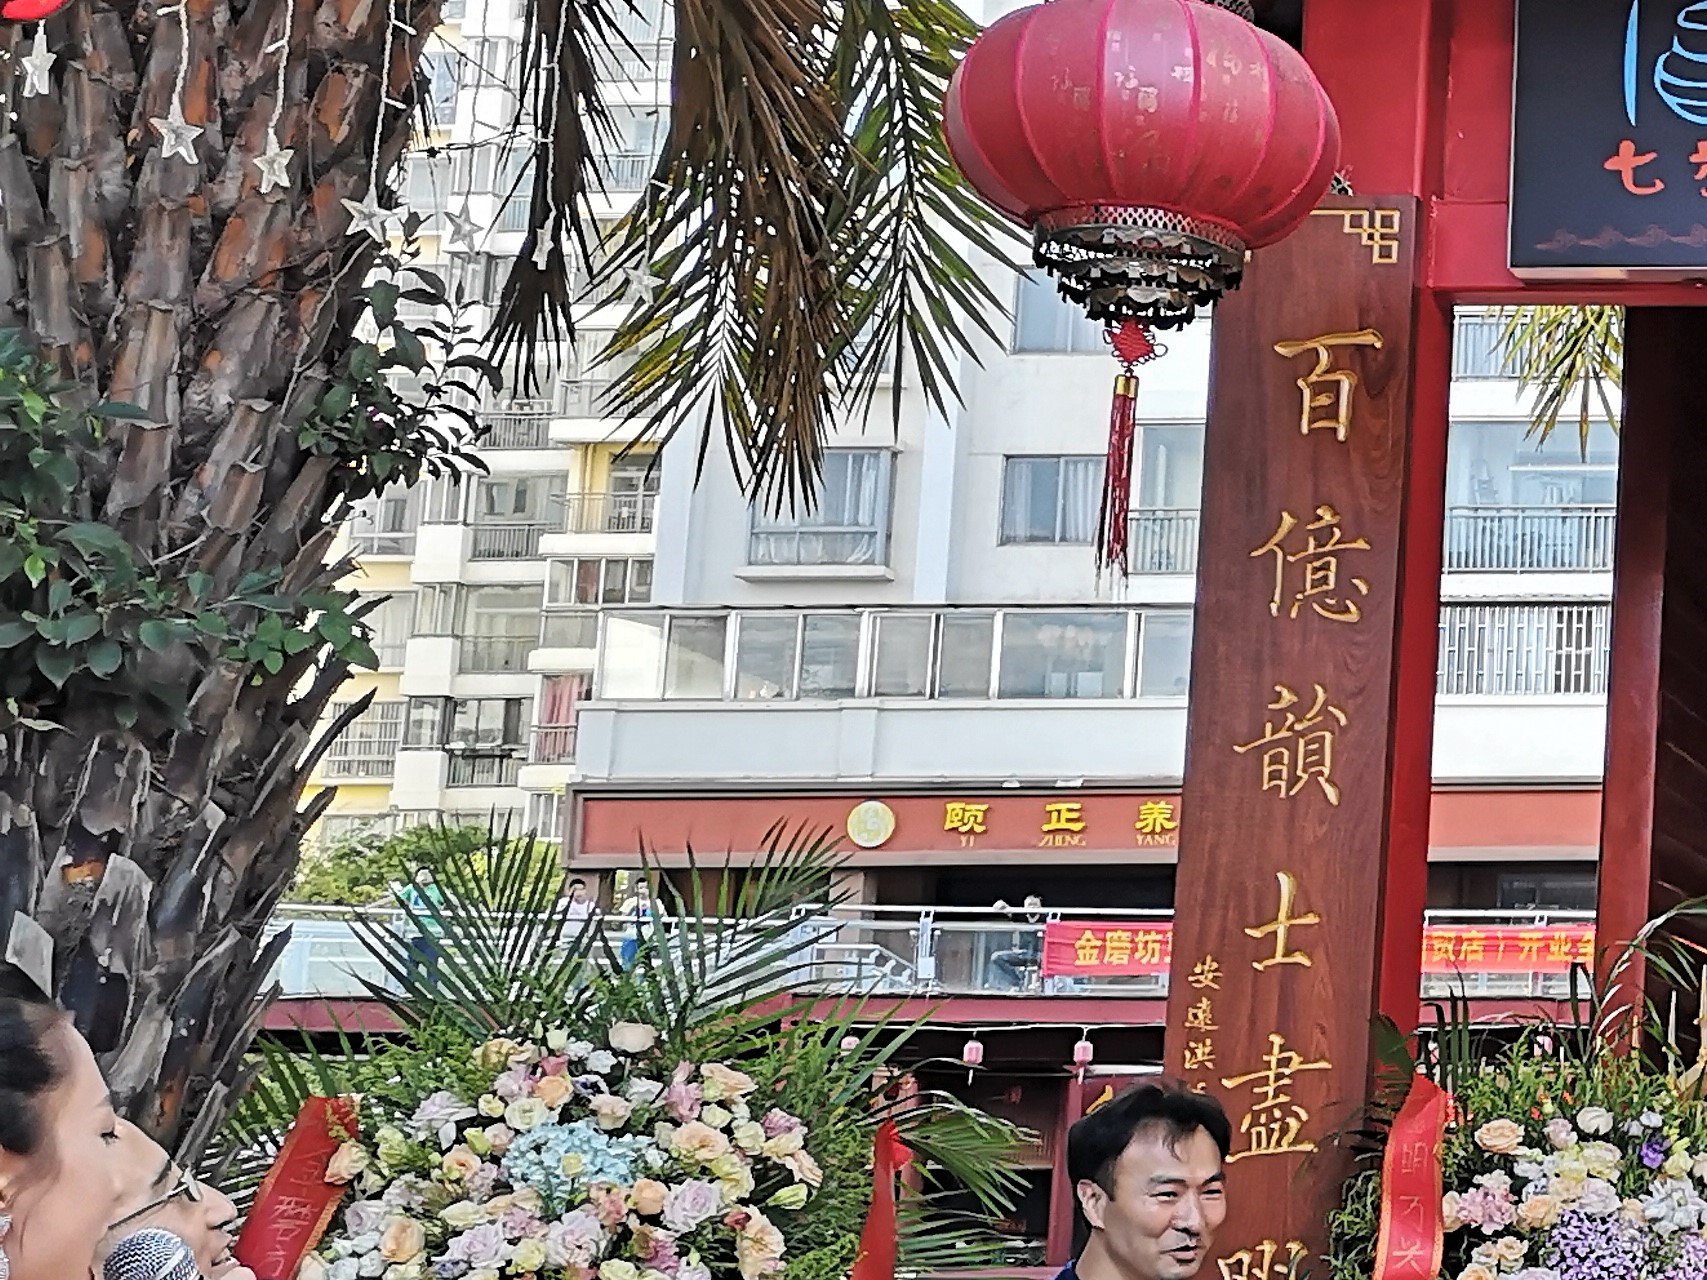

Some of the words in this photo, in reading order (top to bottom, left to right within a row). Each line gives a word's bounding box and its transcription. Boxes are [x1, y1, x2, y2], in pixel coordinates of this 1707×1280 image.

[943, 800, 1178, 833] 颐正养
[1135, 834, 1176, 846] YANG
